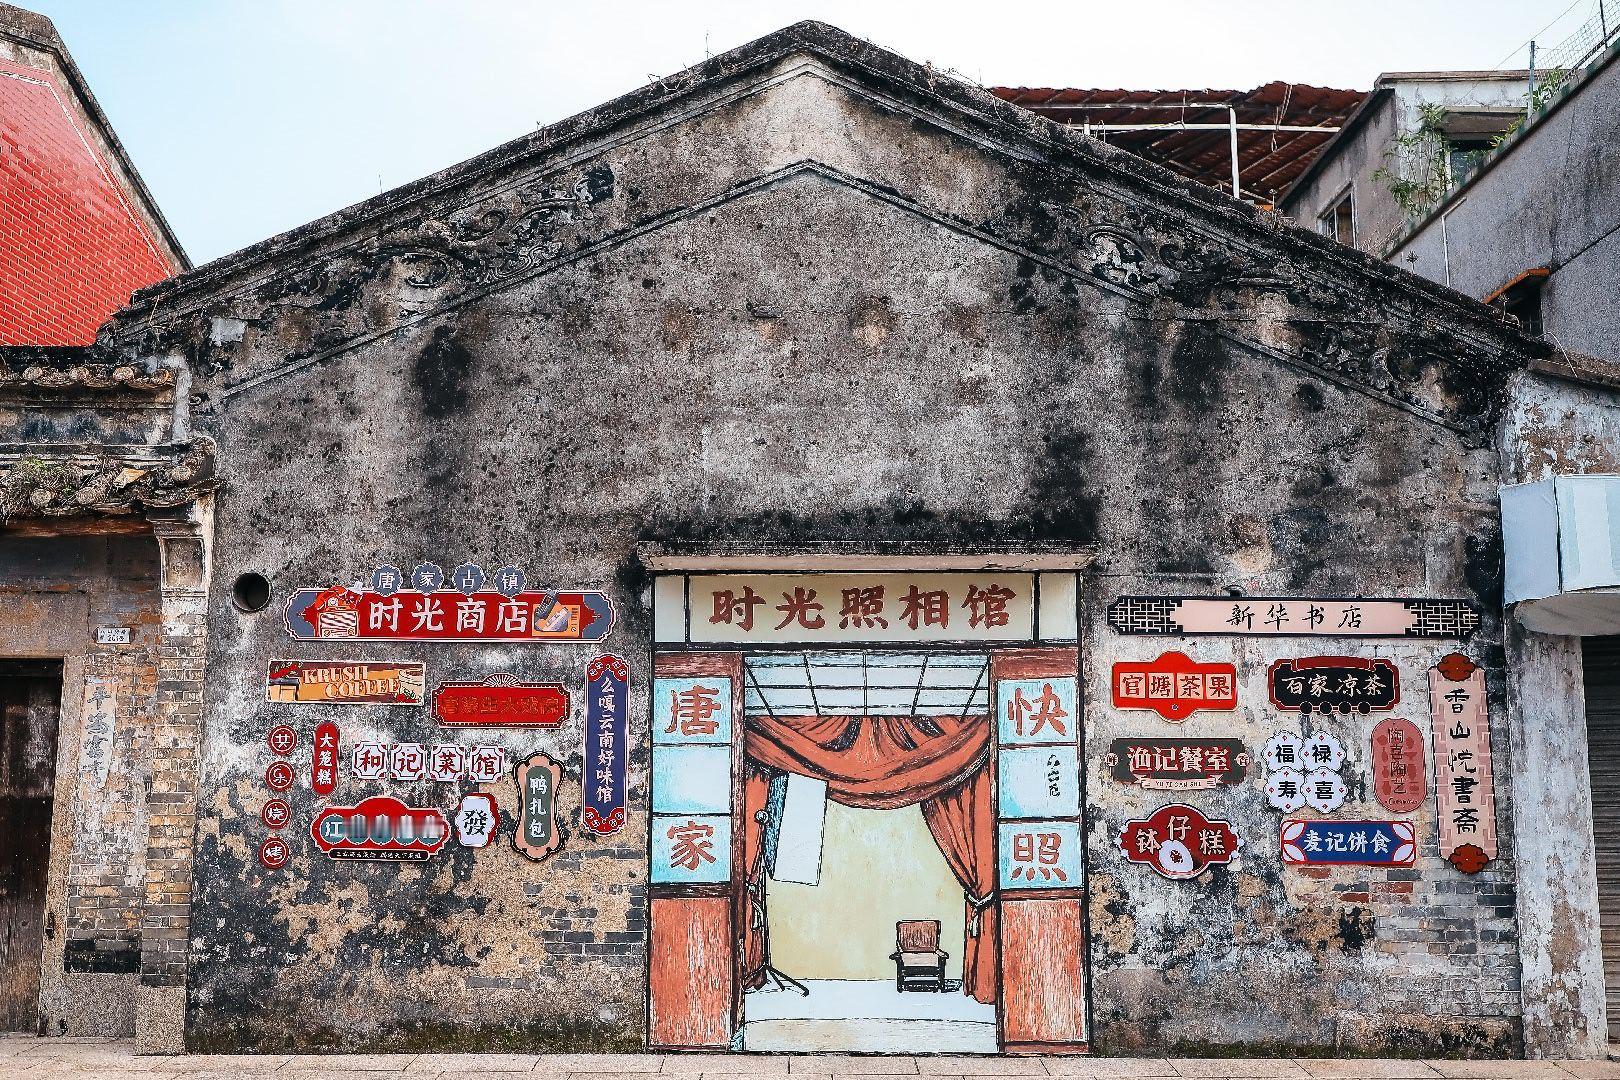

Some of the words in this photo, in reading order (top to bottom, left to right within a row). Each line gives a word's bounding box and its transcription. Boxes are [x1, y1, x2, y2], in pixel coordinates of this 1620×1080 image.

[377, 570, 519, 590] 唐家古镇
[369, 596, 529, 634] 时光商店
[708, 583, 1017, 632] 时光照相馆
[1226, 603, 1362, 631] 新华书店
[302, 665, 369, 684] KRUSH
[325, 678, 400, 698] COFFEE
[1122, 675, 1230, 698] 官塘茶果
[1281, 673, 1386, 697] 百家凉茶
[596, 677, 616, 803] 么嘎云南好味馆
[1275, 744, 1333, 763] 福禄
[316, 733, 334, 785] 大笼糕
[359, 750, 497, 776] 和记菜馆
[1127, 746, 1231, 773] 渔记餐室
[266, 734, 290, 861] 共乐烧烤
[1277, 781, 1334, 799] 寿喜
[529, 775, 548, 838] 鸭扎包
[463, 809, 488, 836] 發
[1136, 815, 1226, 855] 钵仔糕
[1303, 830, 1391, 854] 麦记饼食
